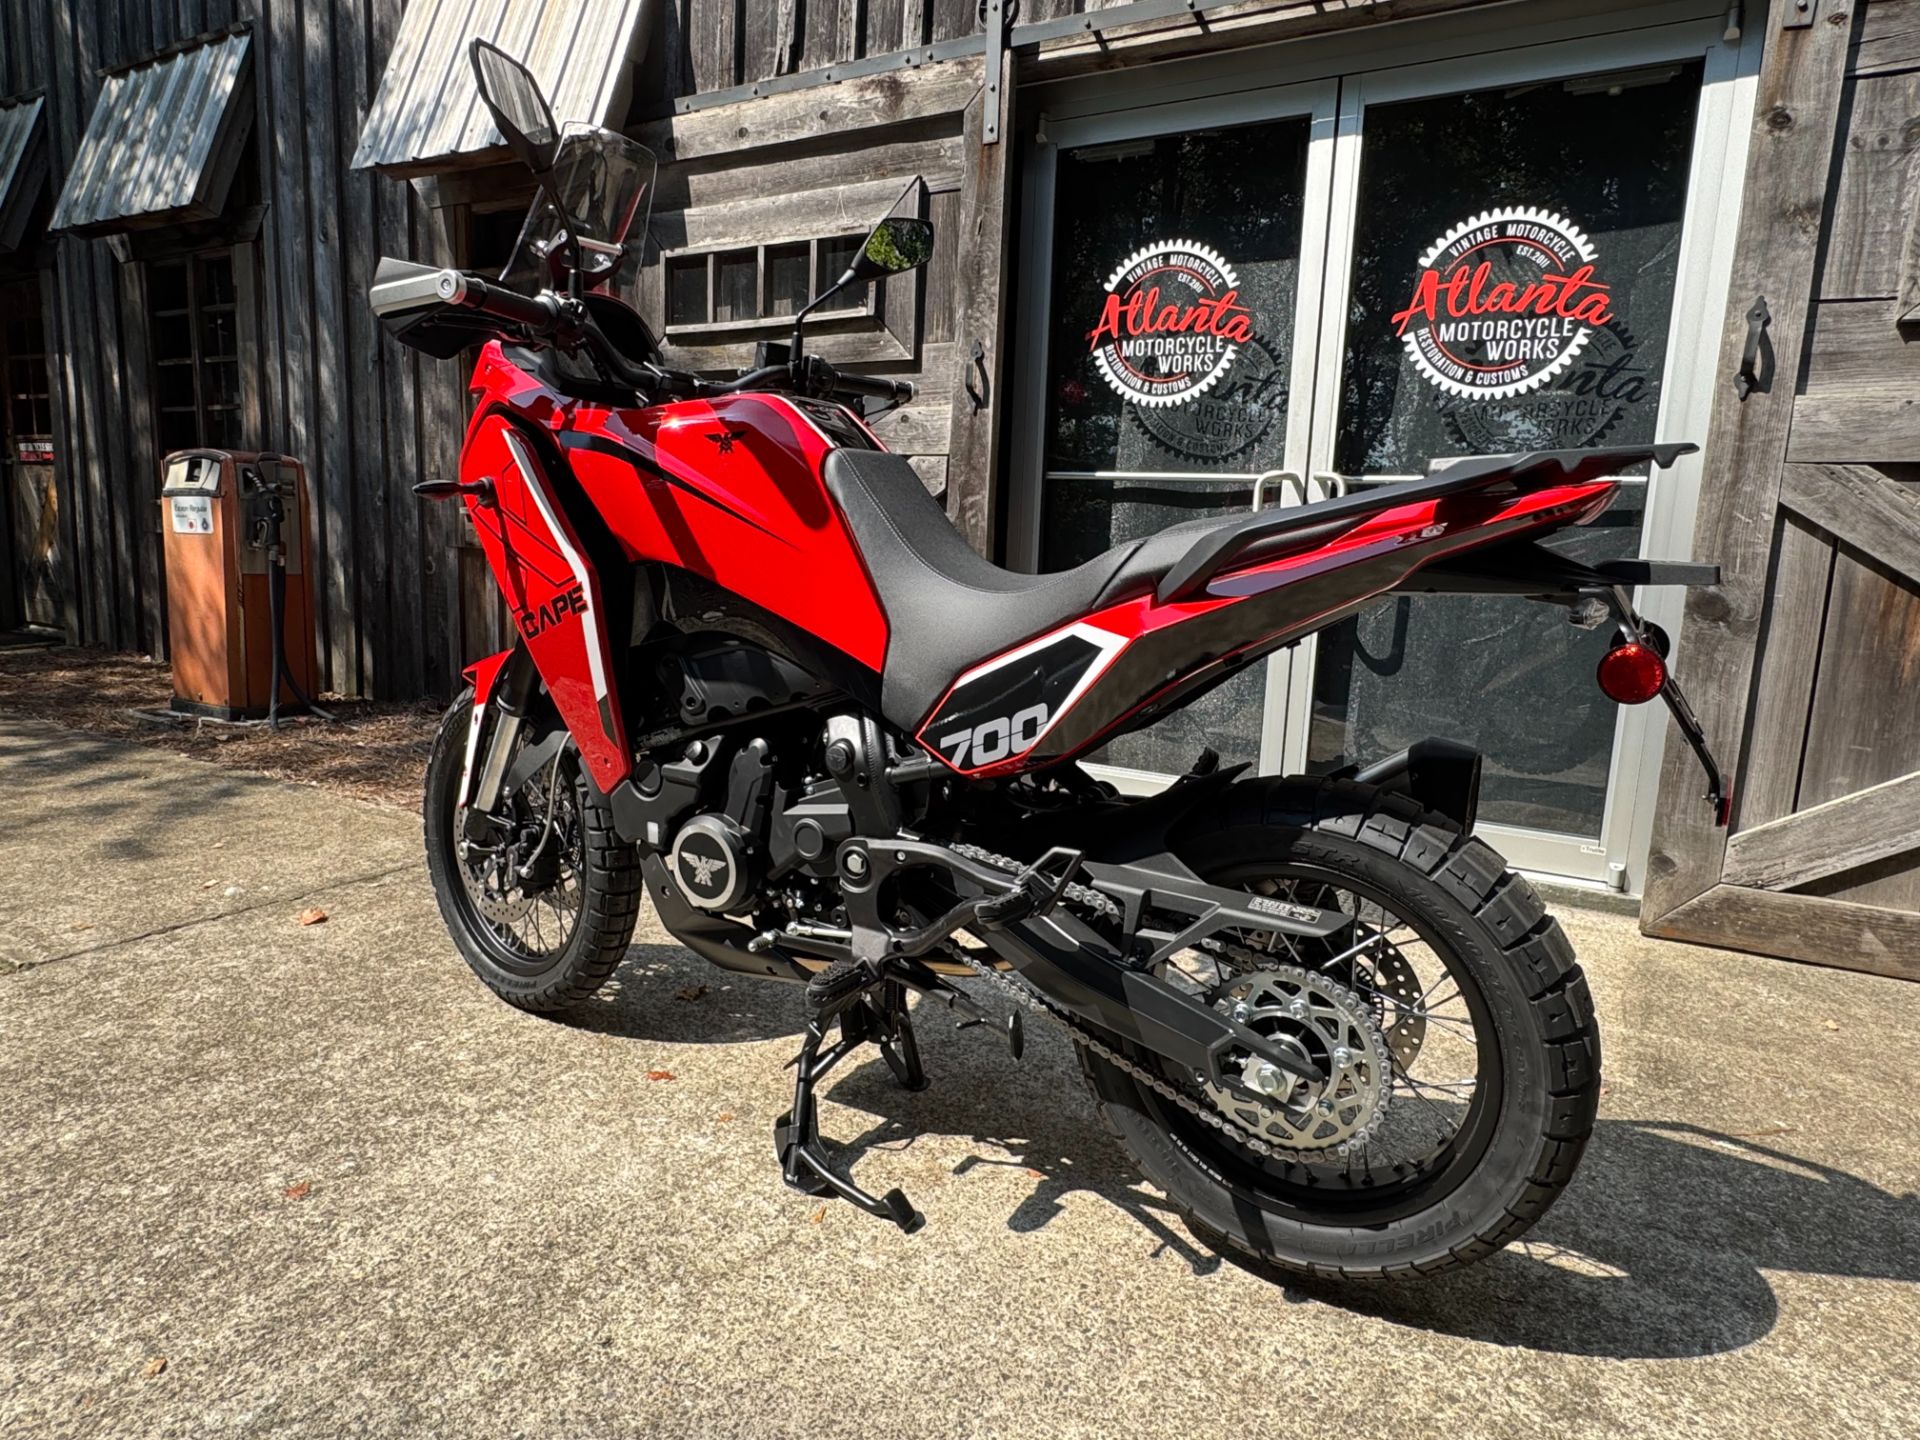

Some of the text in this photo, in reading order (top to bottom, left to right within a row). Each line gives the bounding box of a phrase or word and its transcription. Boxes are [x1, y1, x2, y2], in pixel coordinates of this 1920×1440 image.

[1449, 223, 1575, 262] VINTAGE MOTORCYCLE
[1126, 254, 1223, 289] VINTAGE MOTORCYCLE
[1085, 287, 1254, 351] Atlanta
[1391, 261, 1615, 337] Atlanta
[1122, 335, 1225, 358] MOTORCYCLE
[1439, 317, 1575, 342] MOTORCYCLE
[1486, 338, 1561, 361] WORKS
[1104, 344, 1143, 391] RESTORATION
[1151, 377, 1192, 395] CUSTOMS
[1158, 353, 1214, 374] WORKS
[1416, 327, 1529, 385] RESTORATION & CUSTOMS
[521, 581, 589, 640] CAPE
[940, 702, 1048, 768] 700
